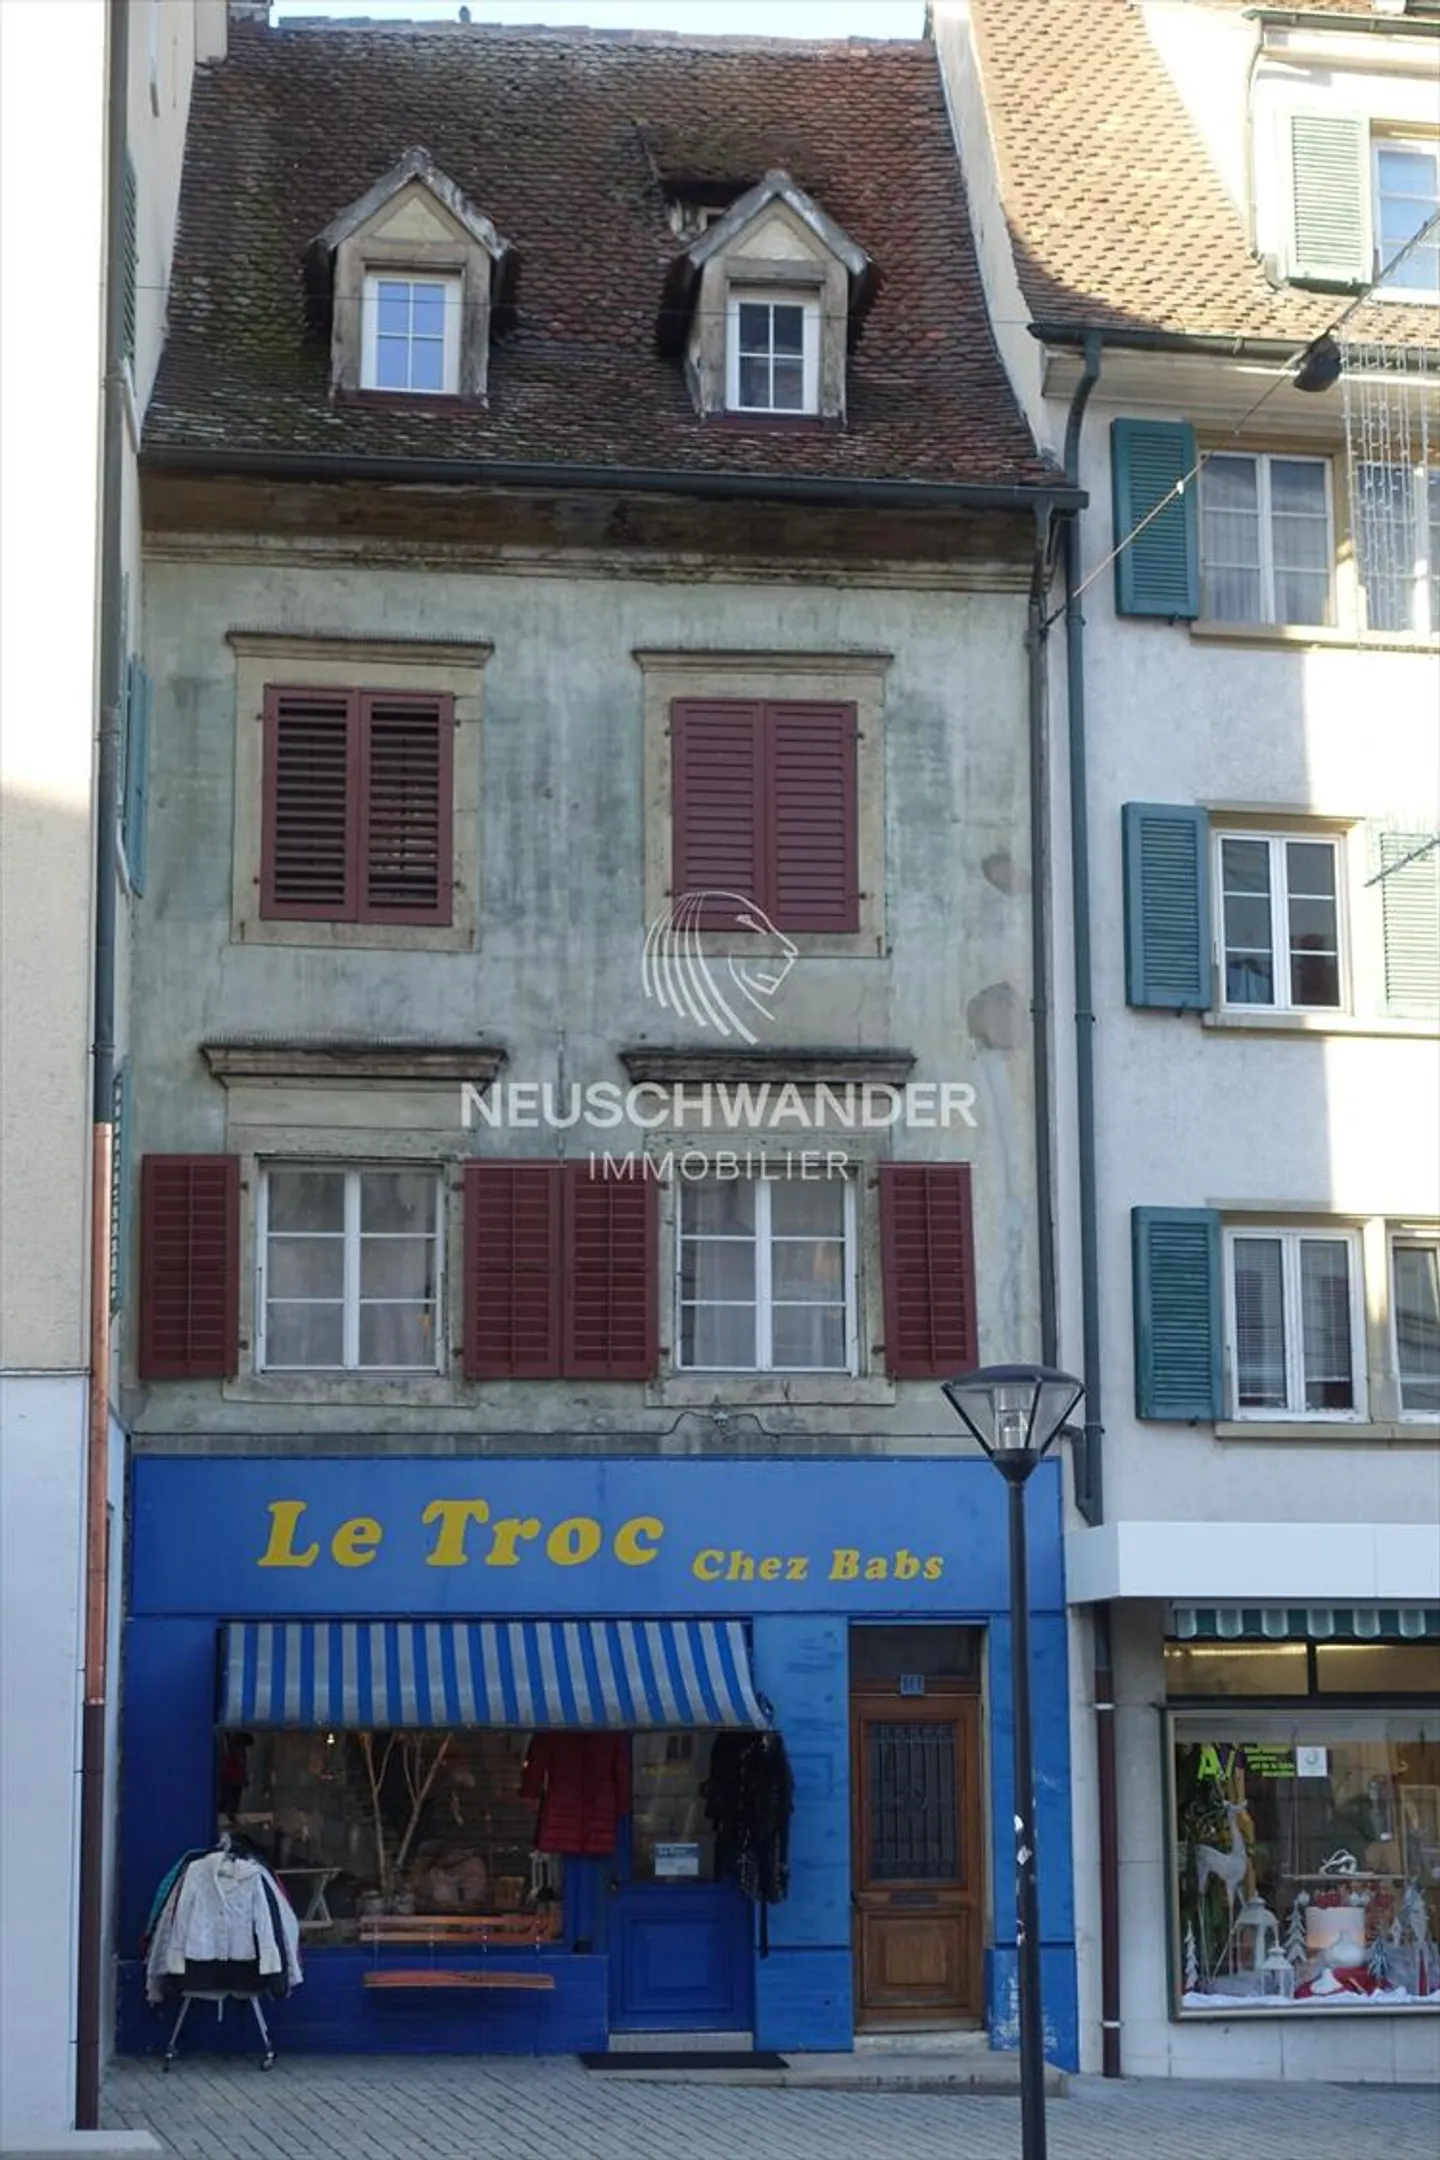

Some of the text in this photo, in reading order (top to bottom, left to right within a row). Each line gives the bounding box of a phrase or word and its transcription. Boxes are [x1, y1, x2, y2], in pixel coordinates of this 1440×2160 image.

[257, 1499, 944, 1581] Le Troc Chez Babs
